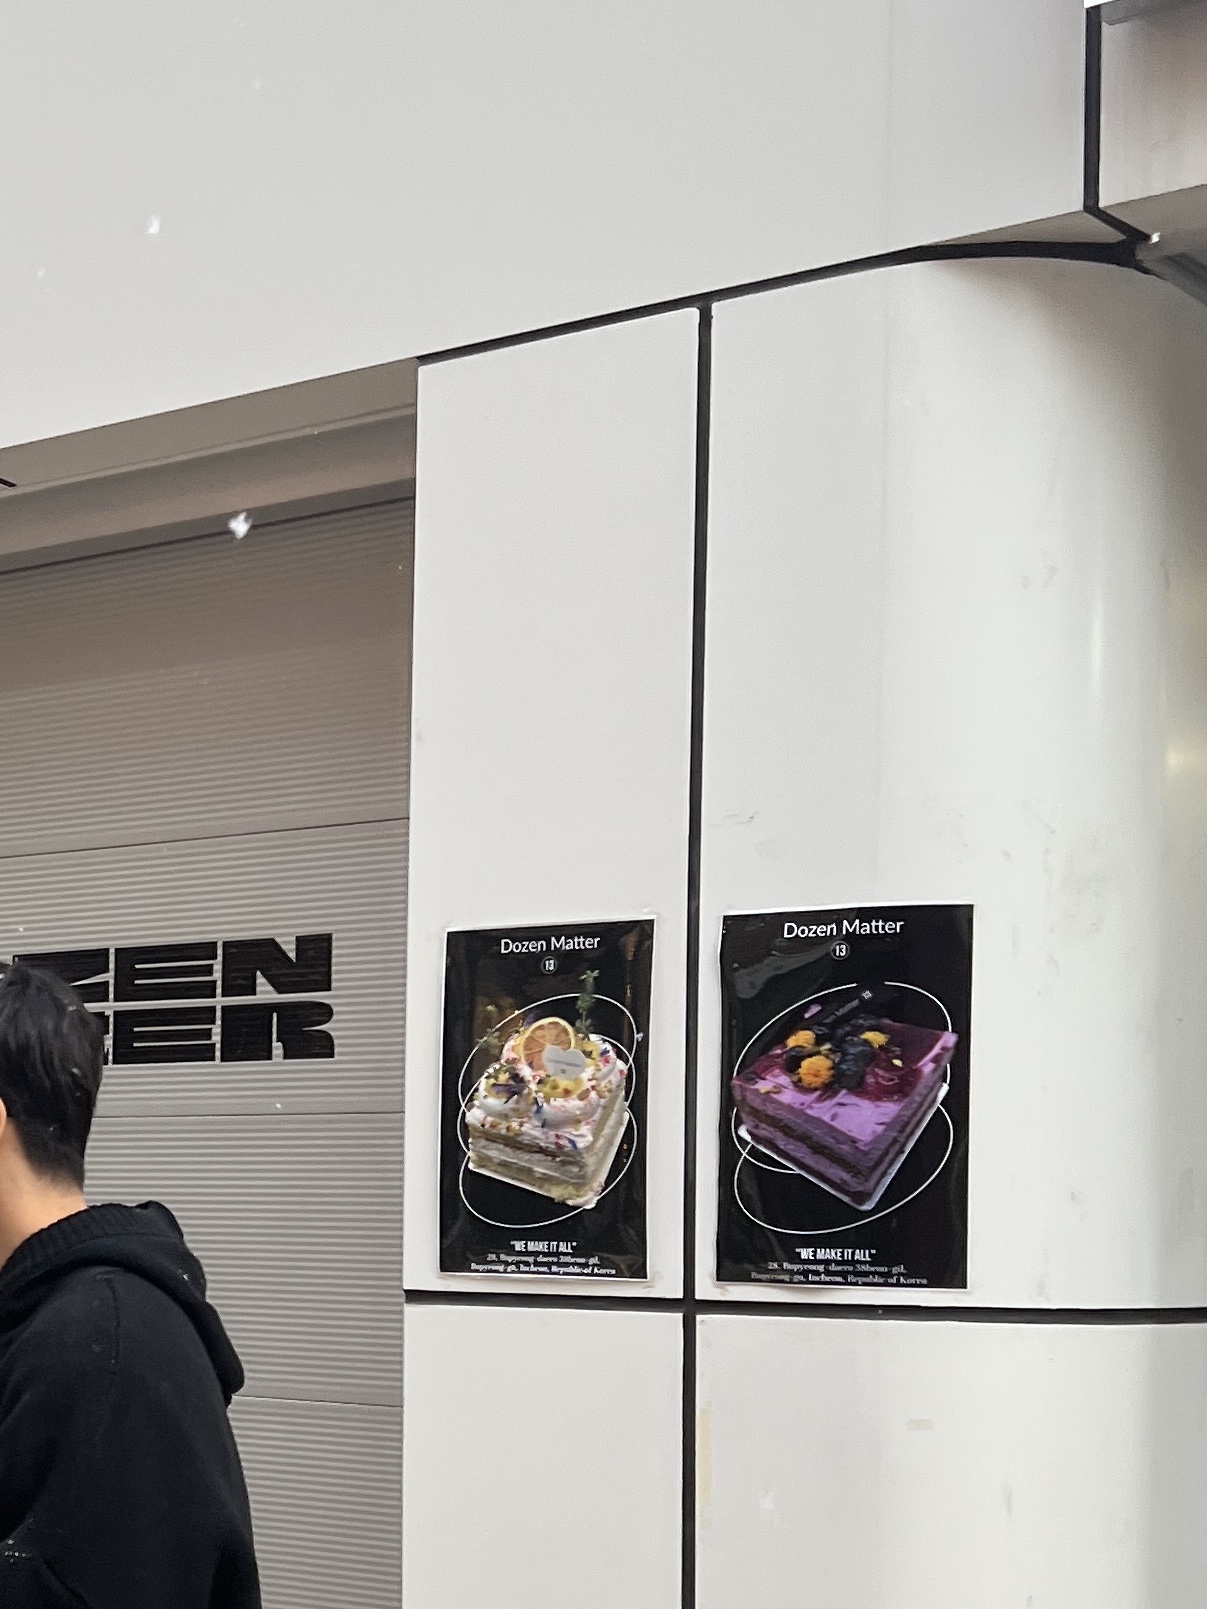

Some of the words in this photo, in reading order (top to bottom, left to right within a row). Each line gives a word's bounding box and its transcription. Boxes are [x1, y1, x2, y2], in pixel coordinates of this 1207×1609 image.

[783, 921, 837, 939] Dozen
[842, 918, 904, 936] Matter
[500, 937, 546, 955] Dozen
[550, 935, 600, 952] Matter
[835, 945, 846, 957] 13
[527, 1241, 549, 1252] MAKE
[816, 1248, 842, 1261] MAKE
[844, 1248, 852, 1261] IT
